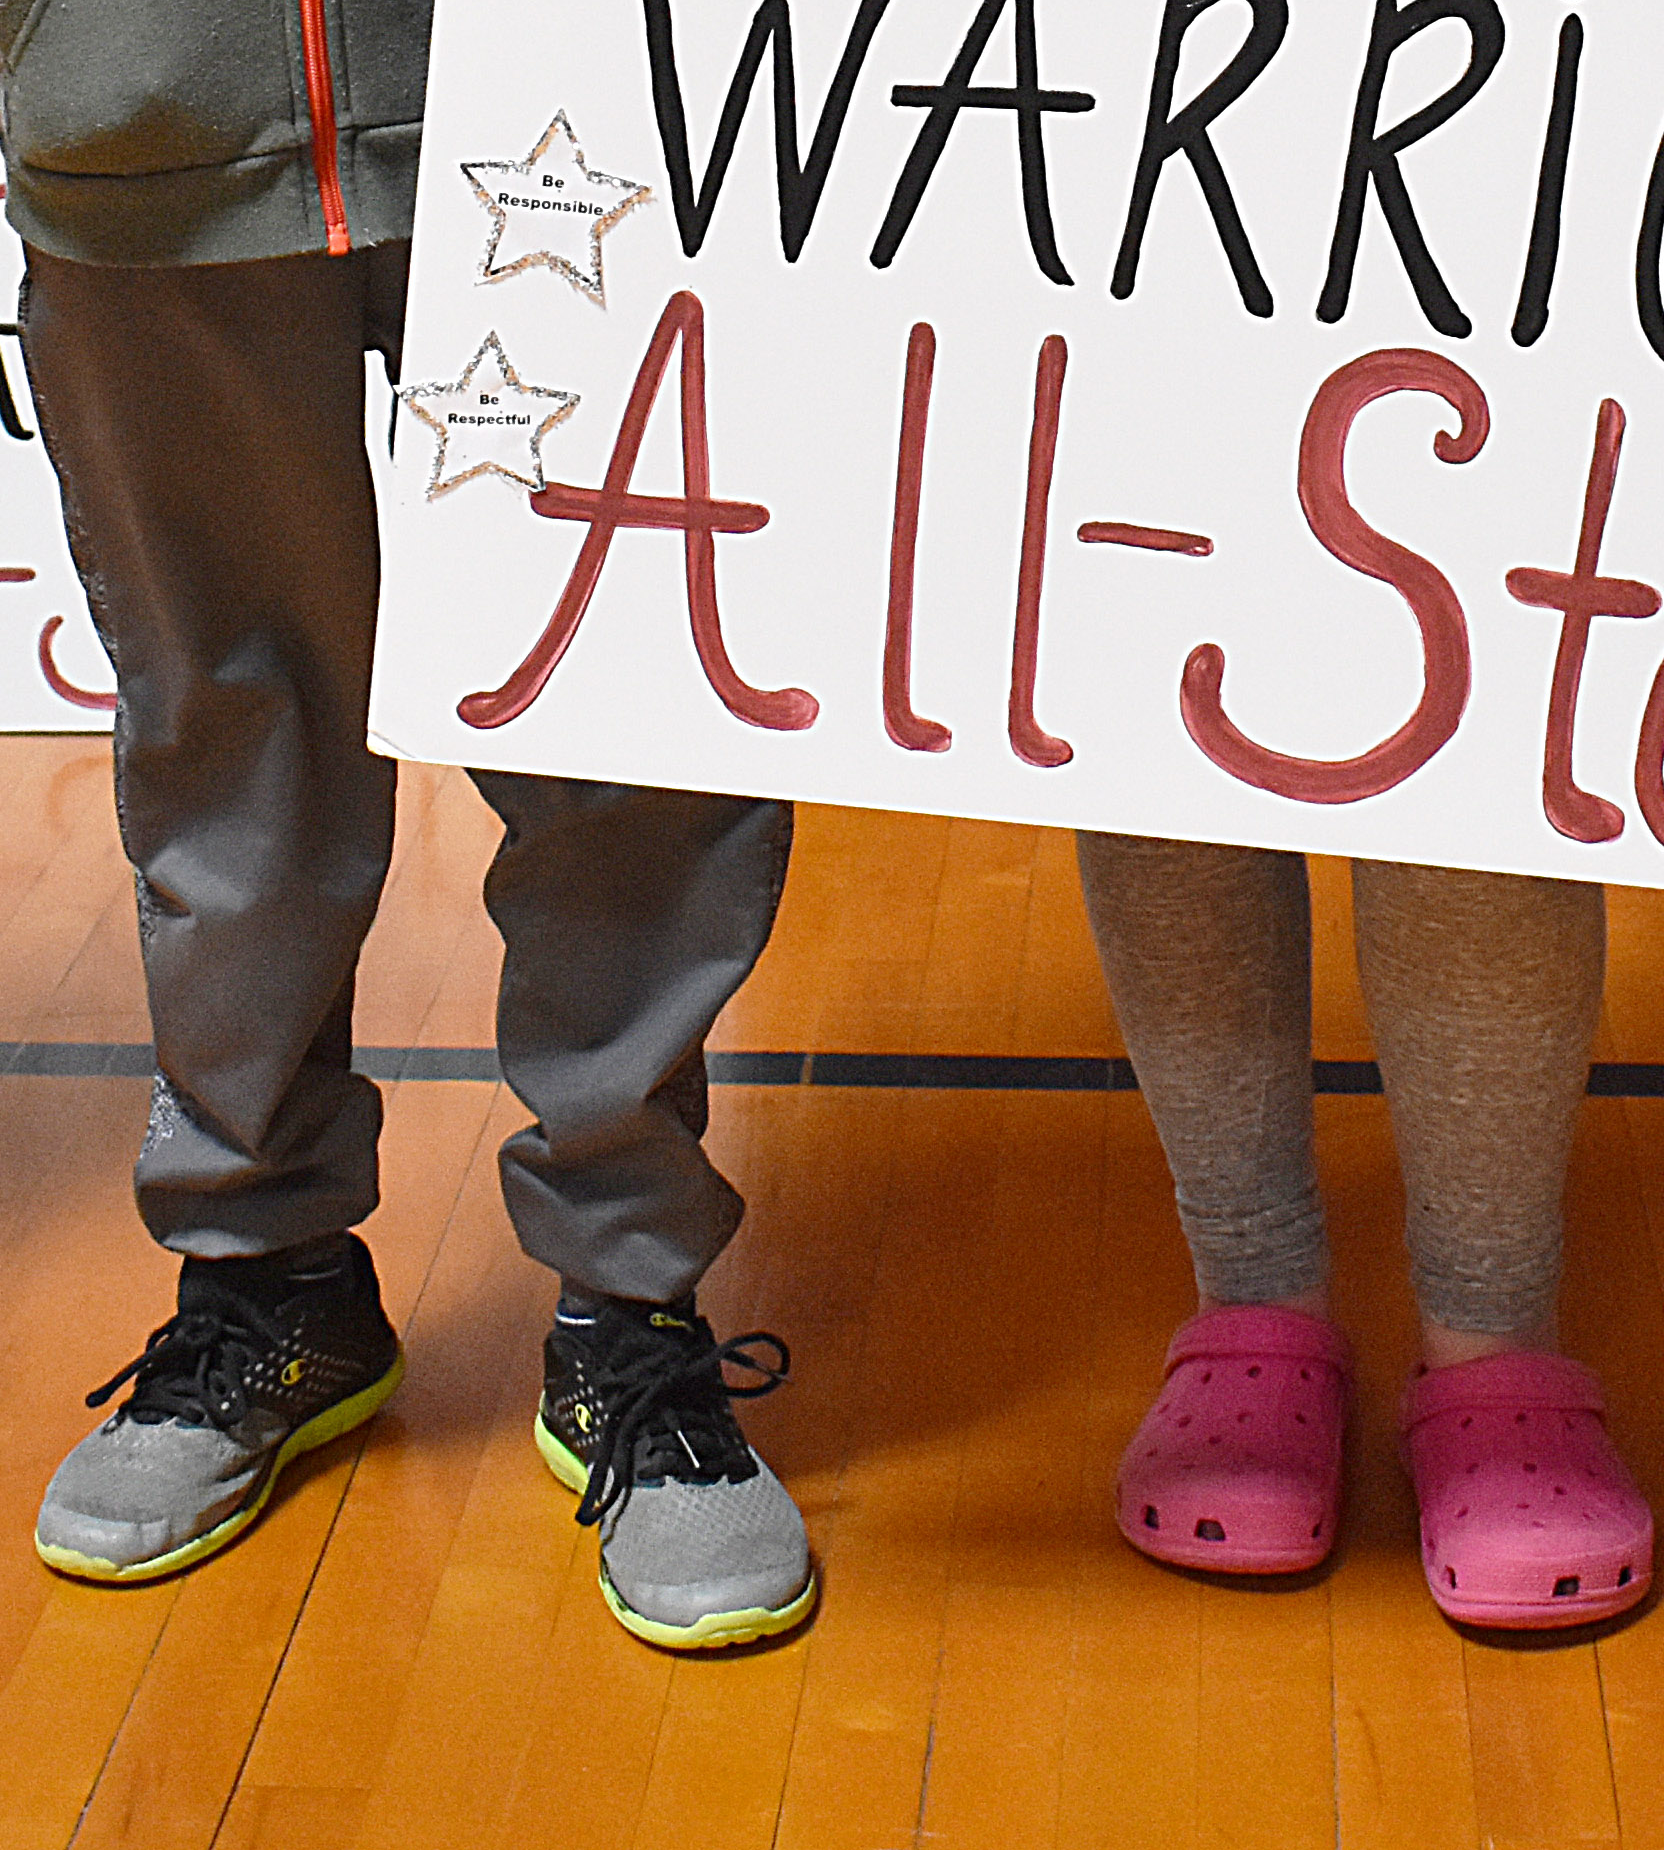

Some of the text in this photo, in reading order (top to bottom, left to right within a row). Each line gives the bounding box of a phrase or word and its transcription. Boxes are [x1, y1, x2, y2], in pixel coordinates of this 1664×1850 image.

[541, 174, 565, 189] Be
[497, 192, 604, 217] Responsible
[479, 394, 500, 406] Be
[447, 412, 532, 427] Respectful
